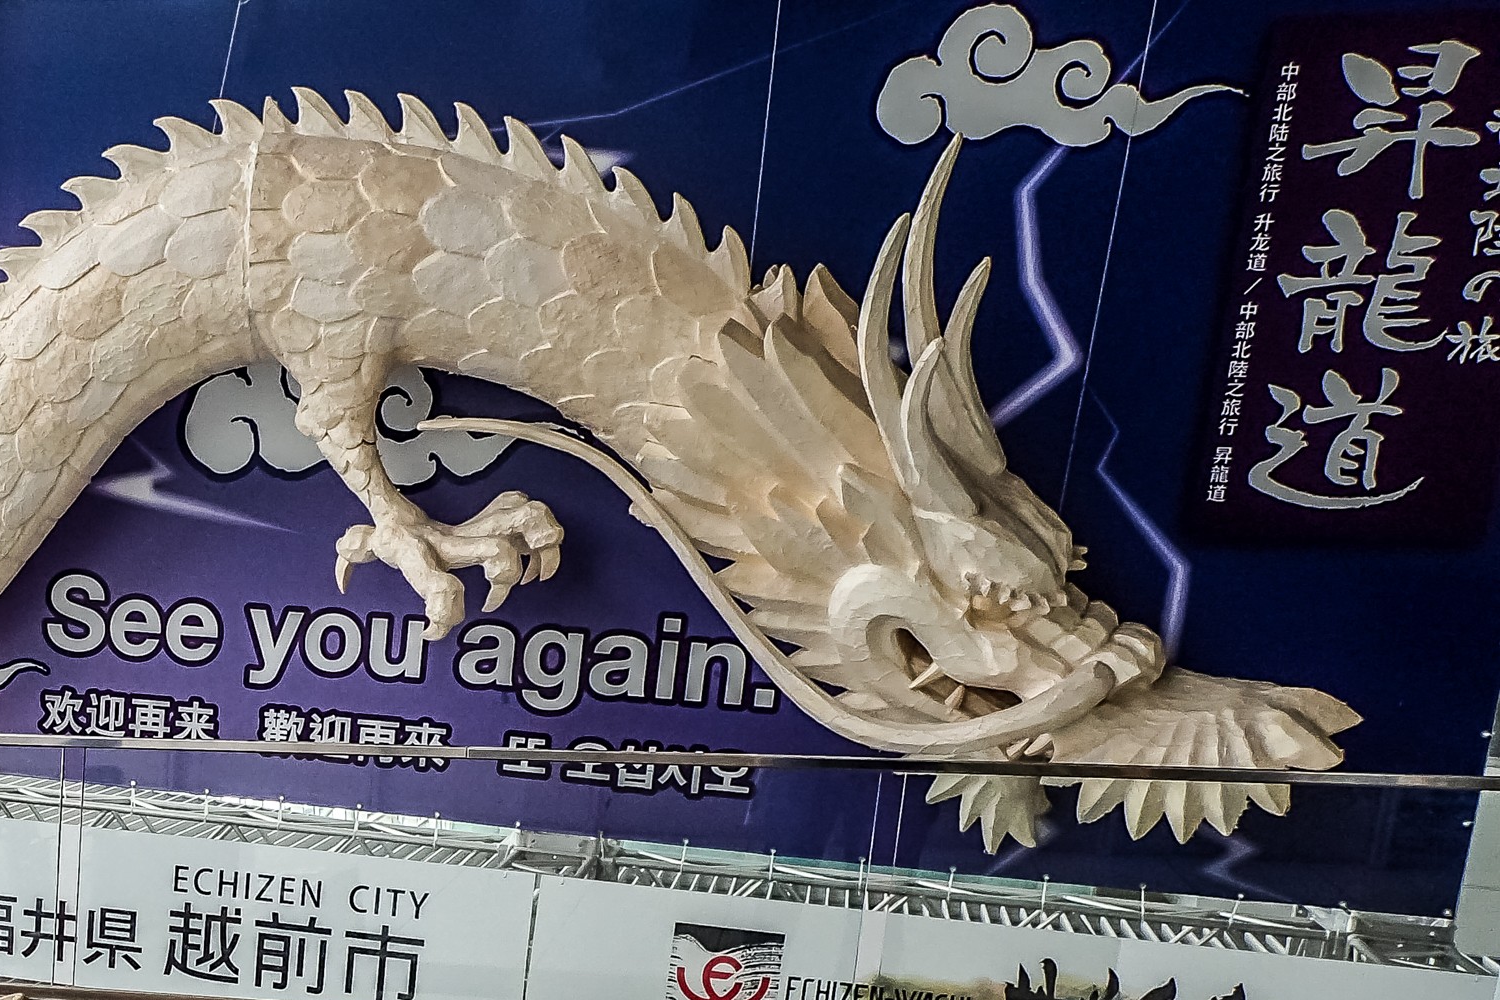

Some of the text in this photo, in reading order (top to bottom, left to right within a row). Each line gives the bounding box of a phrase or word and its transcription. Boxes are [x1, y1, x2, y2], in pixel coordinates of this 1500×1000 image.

[1259, 62, 1299, 203] 中部北陆之旅行
[1246, 213, 1275, 272] 升龙道
[1248, 40, 1480, 509] 昇龍道
[1219, 302, 1258, 436] 中部北陸之旅行
[1206, 446, 1232, 503] 昇龍道
[46, 574, 775, 710] See you again.
[42, 691, 214, 740] 欢迎再来
[174, 865, 429, 920] ECHIZEN CITY
